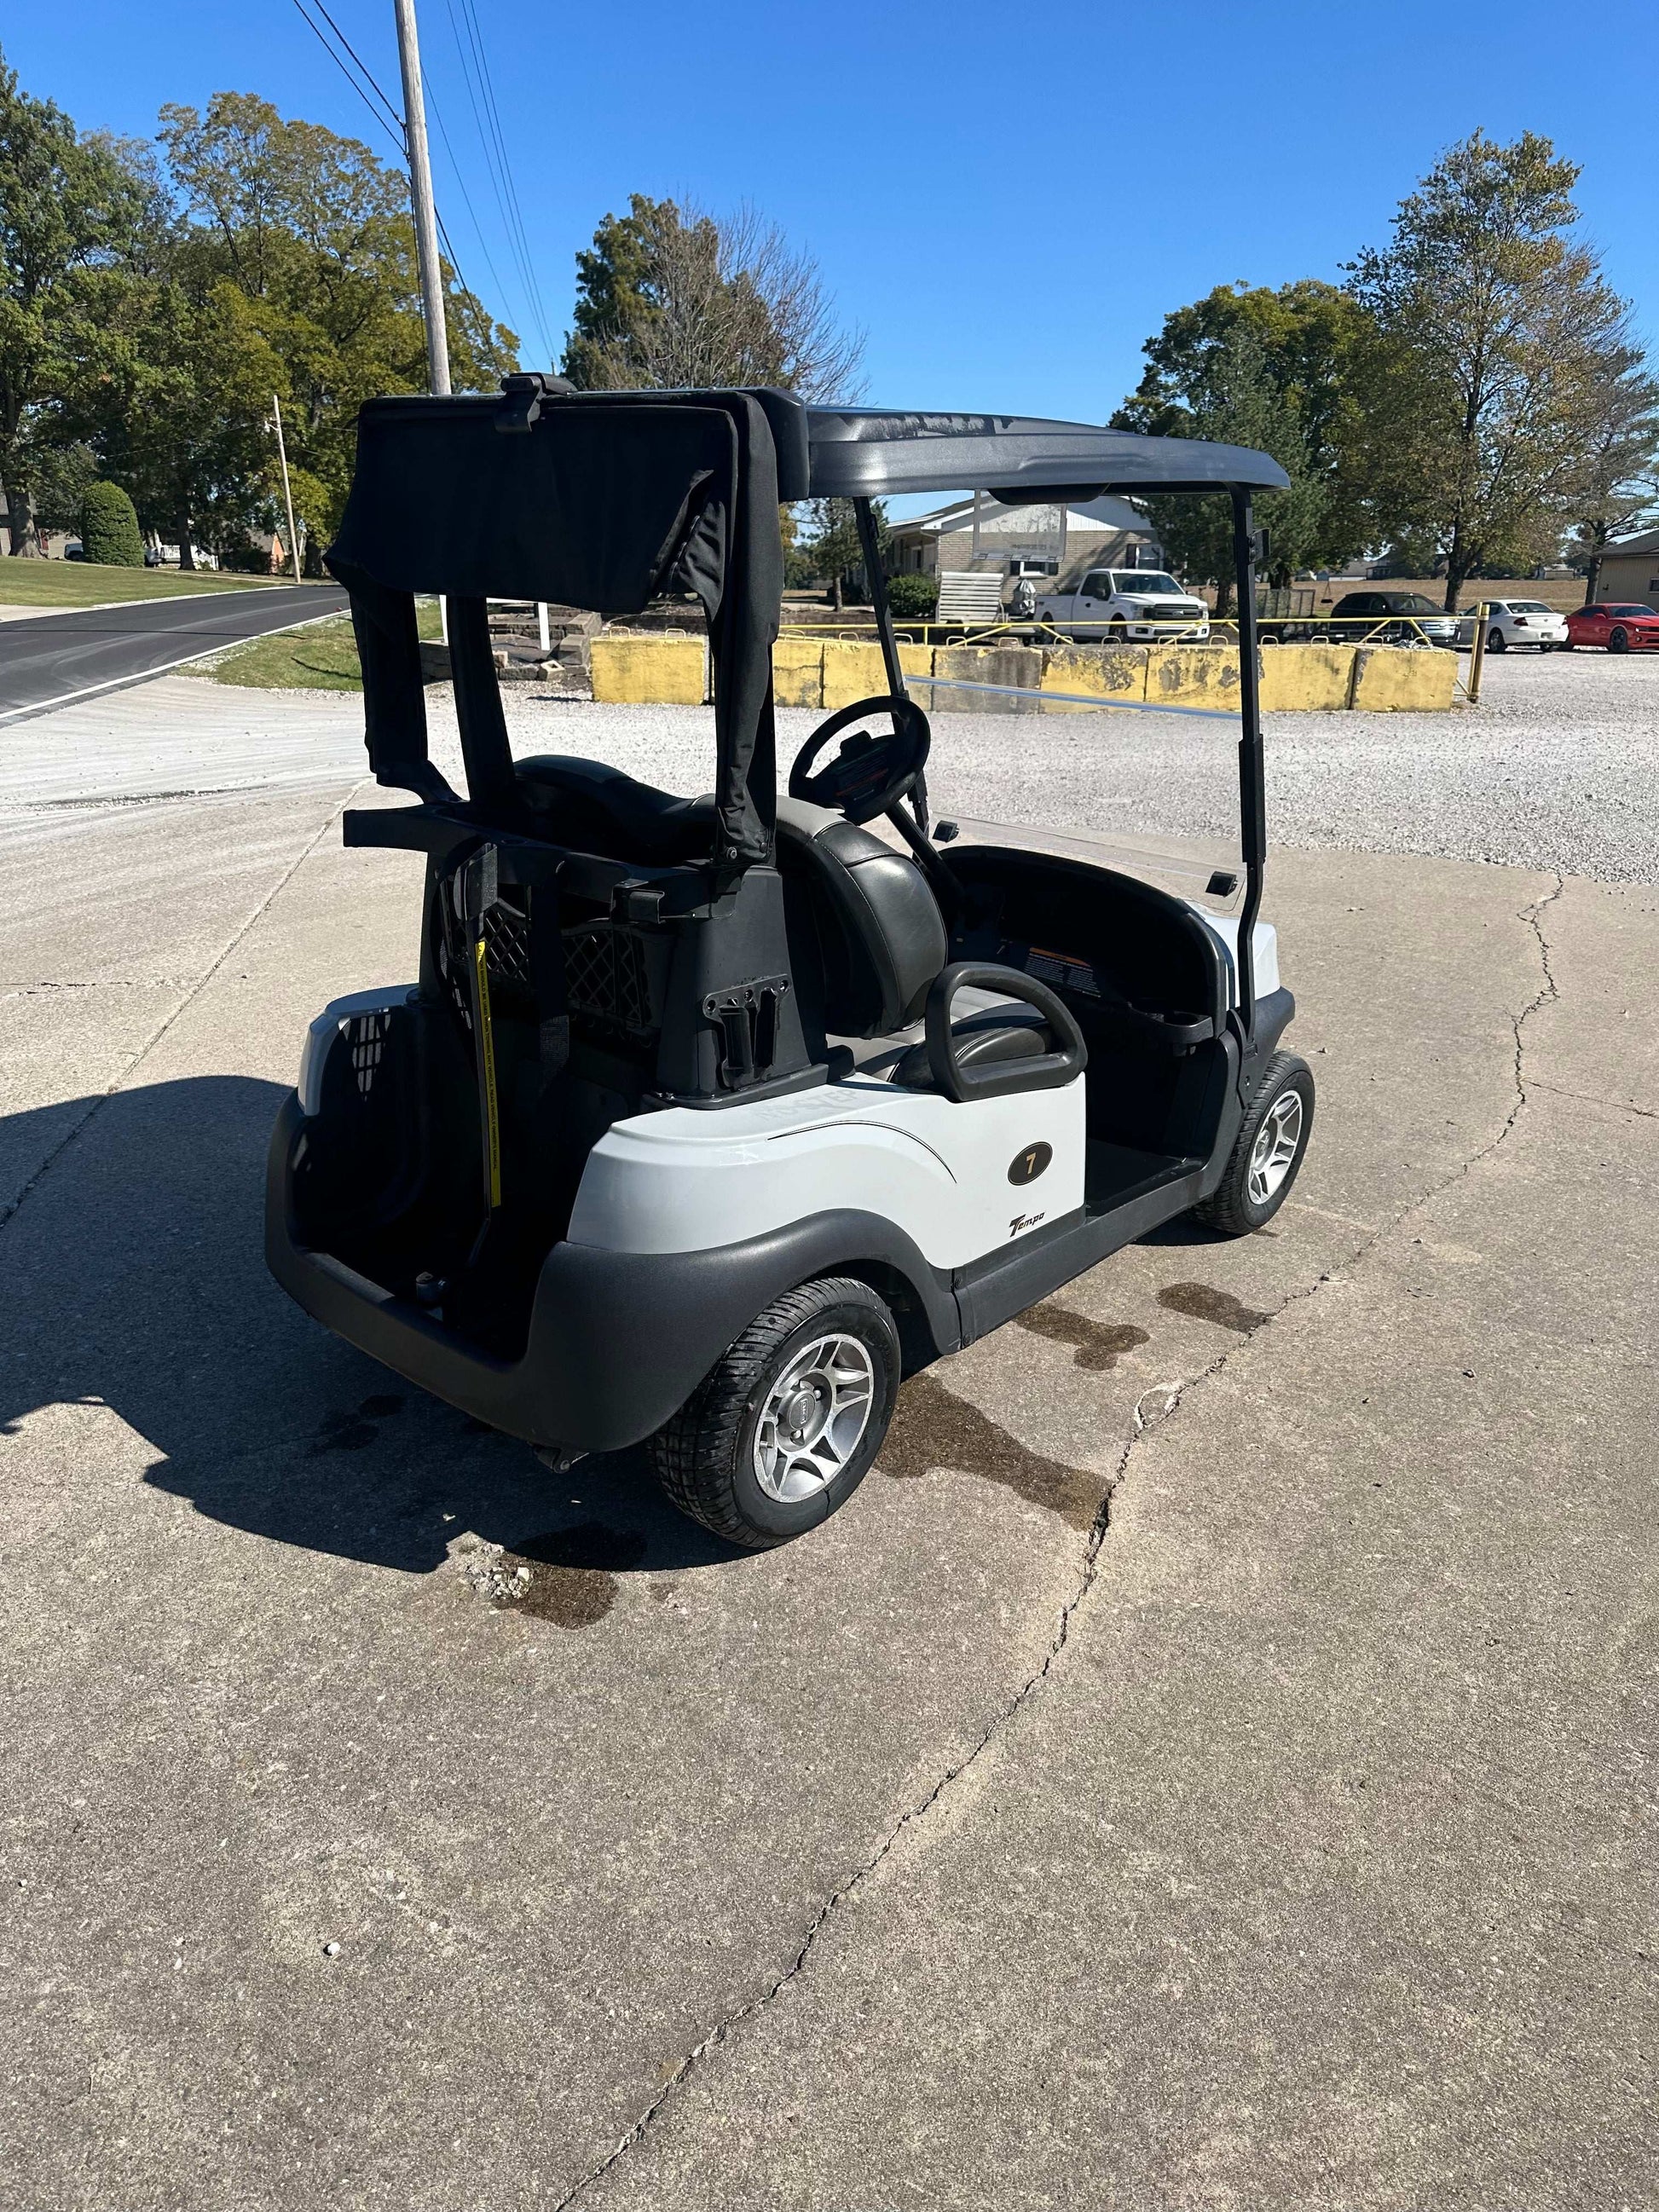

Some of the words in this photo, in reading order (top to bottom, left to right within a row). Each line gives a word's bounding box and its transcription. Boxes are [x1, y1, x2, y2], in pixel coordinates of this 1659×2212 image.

[793, 1090, 858, 1111] STEP
[1026, 1152, 1037, 1175] 7
[1009, 1212, 1045, 1238] Tempo
